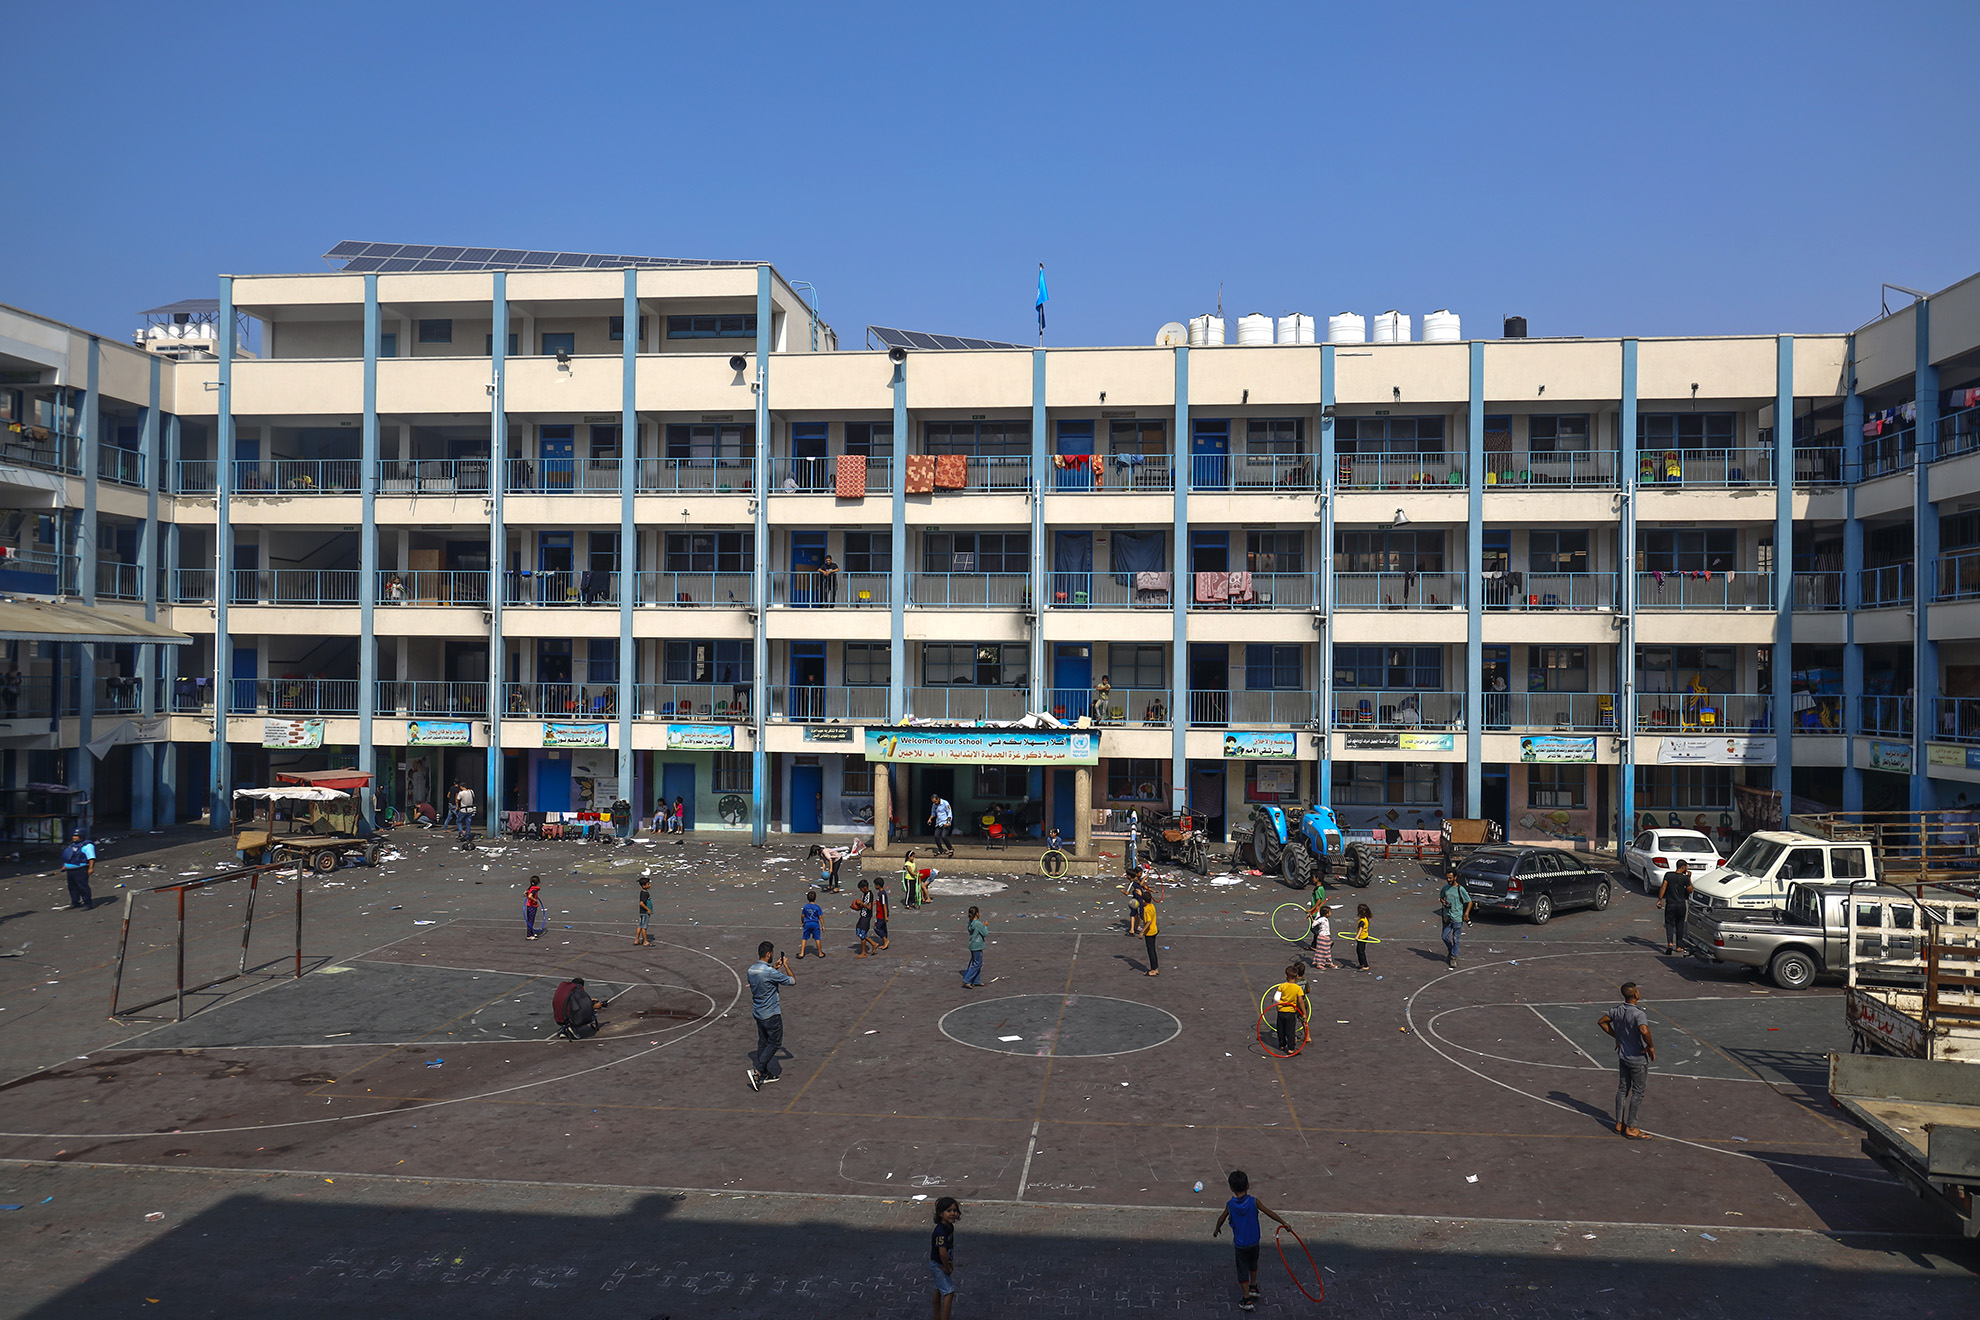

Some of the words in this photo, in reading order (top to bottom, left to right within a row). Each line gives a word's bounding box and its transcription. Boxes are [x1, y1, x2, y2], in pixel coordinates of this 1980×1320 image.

[958, 737, 983, 745] School
[988, 738, 1001, 747] في
[1002, 738, 1022, 747] بكم
[1023, 738, 1049, 747] وسهلا
[950, 749, 980, 760] الابتدائية
[981, 750, 1007, 760] الجديدة
[1008, 750, 1021, 760] غزة
[1022, 750, 1041, 760] ذكور
[1043, 751, 1065, 760] مدرسة
[1668, 812, 1682, 827] B
[1695, 813, 1707, 826] C
[1720, 813, 1733, 827] D
